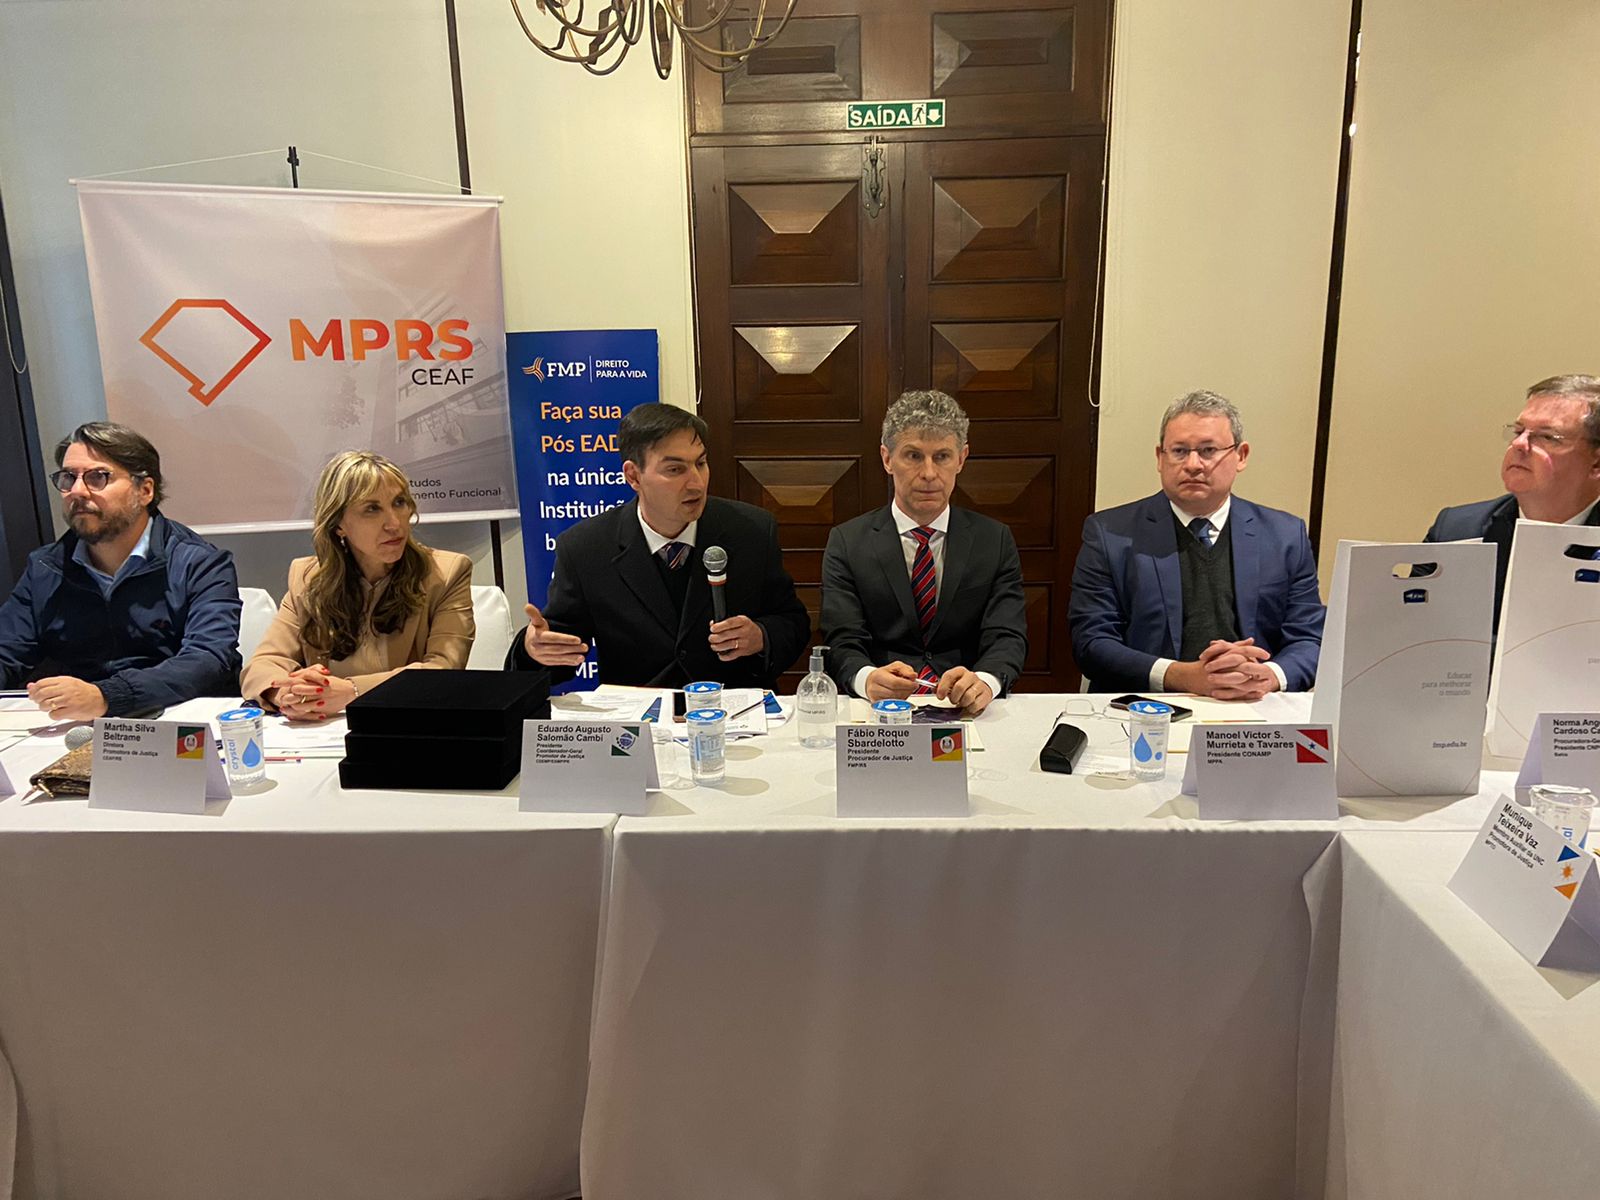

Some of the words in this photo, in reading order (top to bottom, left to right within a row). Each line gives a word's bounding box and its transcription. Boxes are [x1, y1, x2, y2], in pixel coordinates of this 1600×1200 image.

[850, 105, 911, 126] SAÍDA
[289, 319, 474, 361] MPRS
[547, 362, 586, 377] FMP
[595, 360, 629, 368] DIREITO
[412, 368, 474, 386] CEAF
[596, 370, 619, 378] PARA
[619, 370, 626, 378] A
[627, 370, 647, 378] VIDA
[541, 402, 583, 423] Faça
[589, 405, 622, 419] sua
[541, 435, 575, 453] Pós
[547, 472, 570, 486] na
[575, 467, 627, 485] única
[410, 478, 441, 488] tudos
[449, 488, 501, 498] Funcional
[104, 722, 133, 732] Martha
[135, 723, 155, 733] Silva
[1582, 719, 1600, 728] Ang
[537, 725, 574, 733] Eduardo
[575, 725, 612, 735] Augusto
[847, 728, 875, 738] Fábio
[878, 728, 910, 739] Roque
[1206, 731, 1241, 739] Manoel
[1243, 731, 1272, 739] Victor
[1273, 730, 1284, 739] S.
[103, 731, 141, 742] Beltrame
[537, 733, 574, 742] Salomão
[576, 734, 603, 742] Cambi
[847, 738, 905, 748] Sbardelotto
[1207, 740, 1246, 749] Murrieta
[1257, 740, 1294, 749] Tavares
[227, 739, 240, 770] crystal
[1502, 803, 1533, 830] Munique
[1498, 813, 1525, 839] Teixeira
[1525, 832, 1539, 849] Vaz
